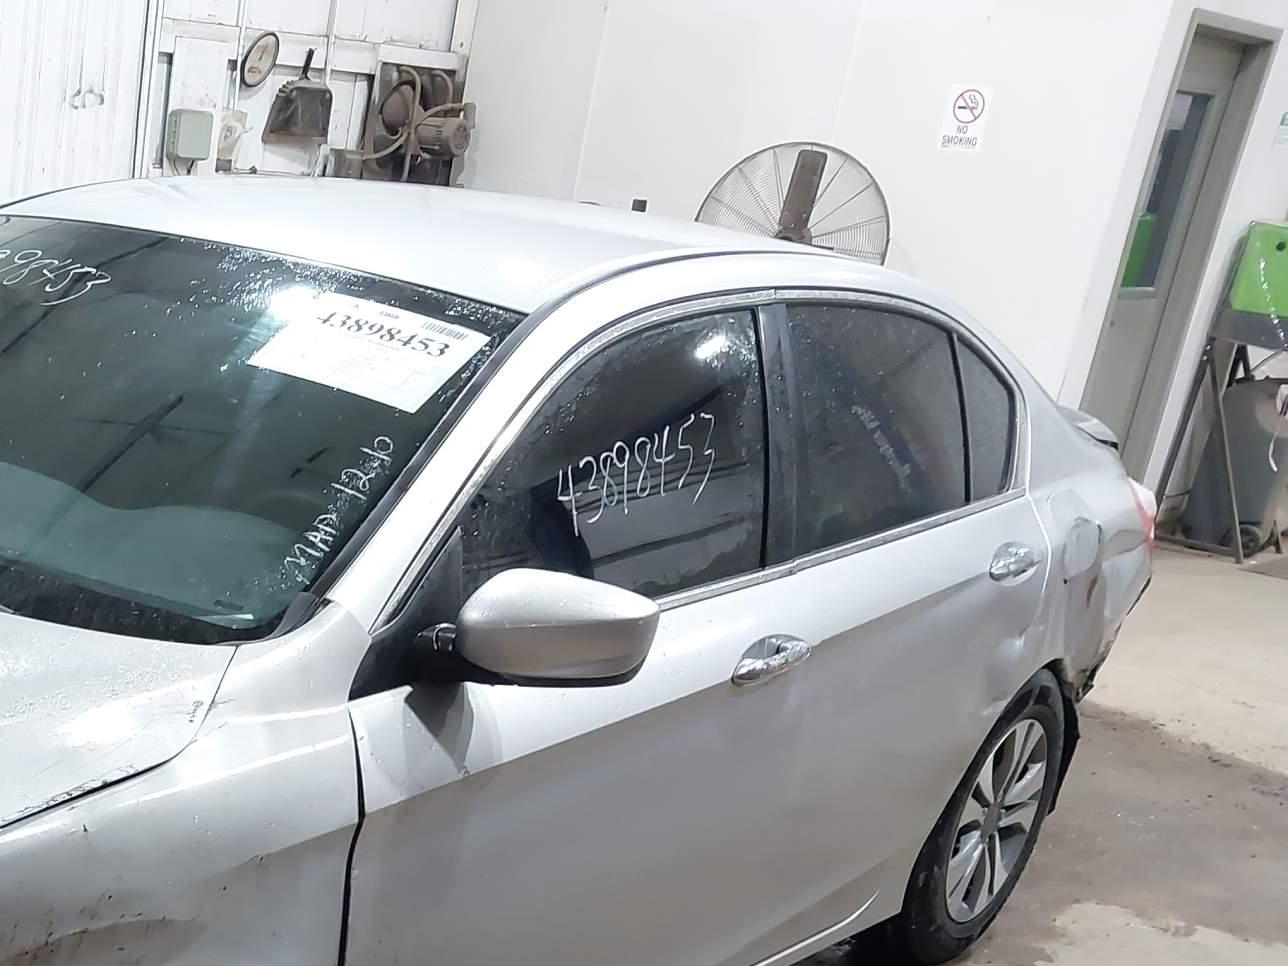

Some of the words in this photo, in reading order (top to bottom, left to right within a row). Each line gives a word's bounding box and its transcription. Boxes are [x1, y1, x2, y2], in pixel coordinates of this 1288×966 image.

[942, 135, 978, 146] SMOKING
[956, 125, 968, 134] NO
[316, 311, 450, 357] 43898453
[557, 412, 715, 537] 43898453
